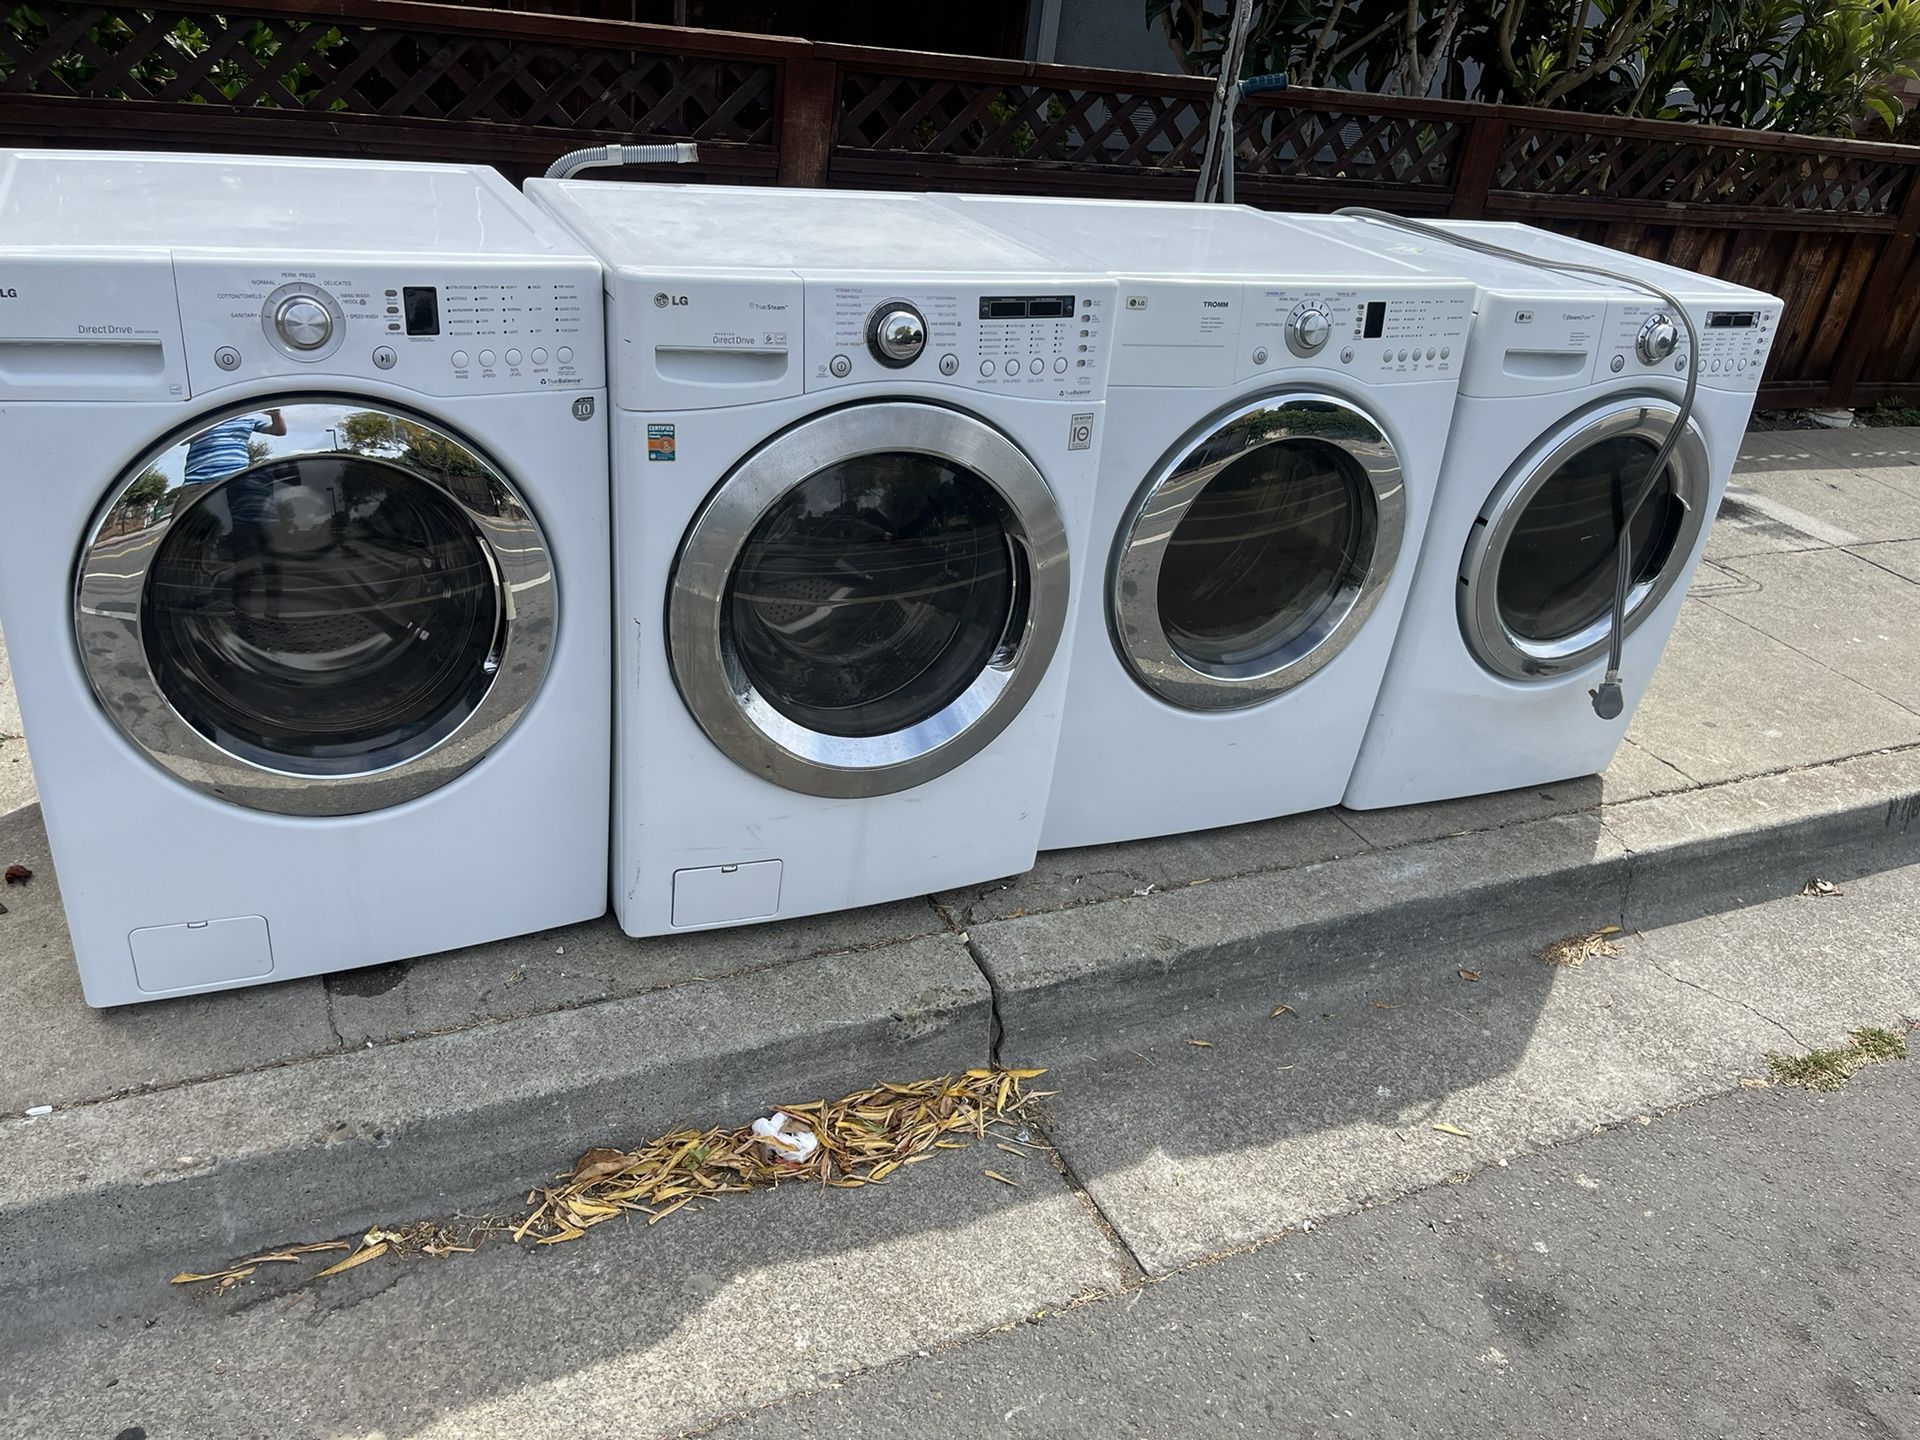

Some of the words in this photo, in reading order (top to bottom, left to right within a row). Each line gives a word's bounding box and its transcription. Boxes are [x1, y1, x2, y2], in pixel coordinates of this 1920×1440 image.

[0, 288, 18, 299] LG
[671, 295, 689, 306] LG
[1203, 300, 1229, 308] TROMM
[577, 403, 591, 415] 10
[1072, 426, 1089, 442] 10
